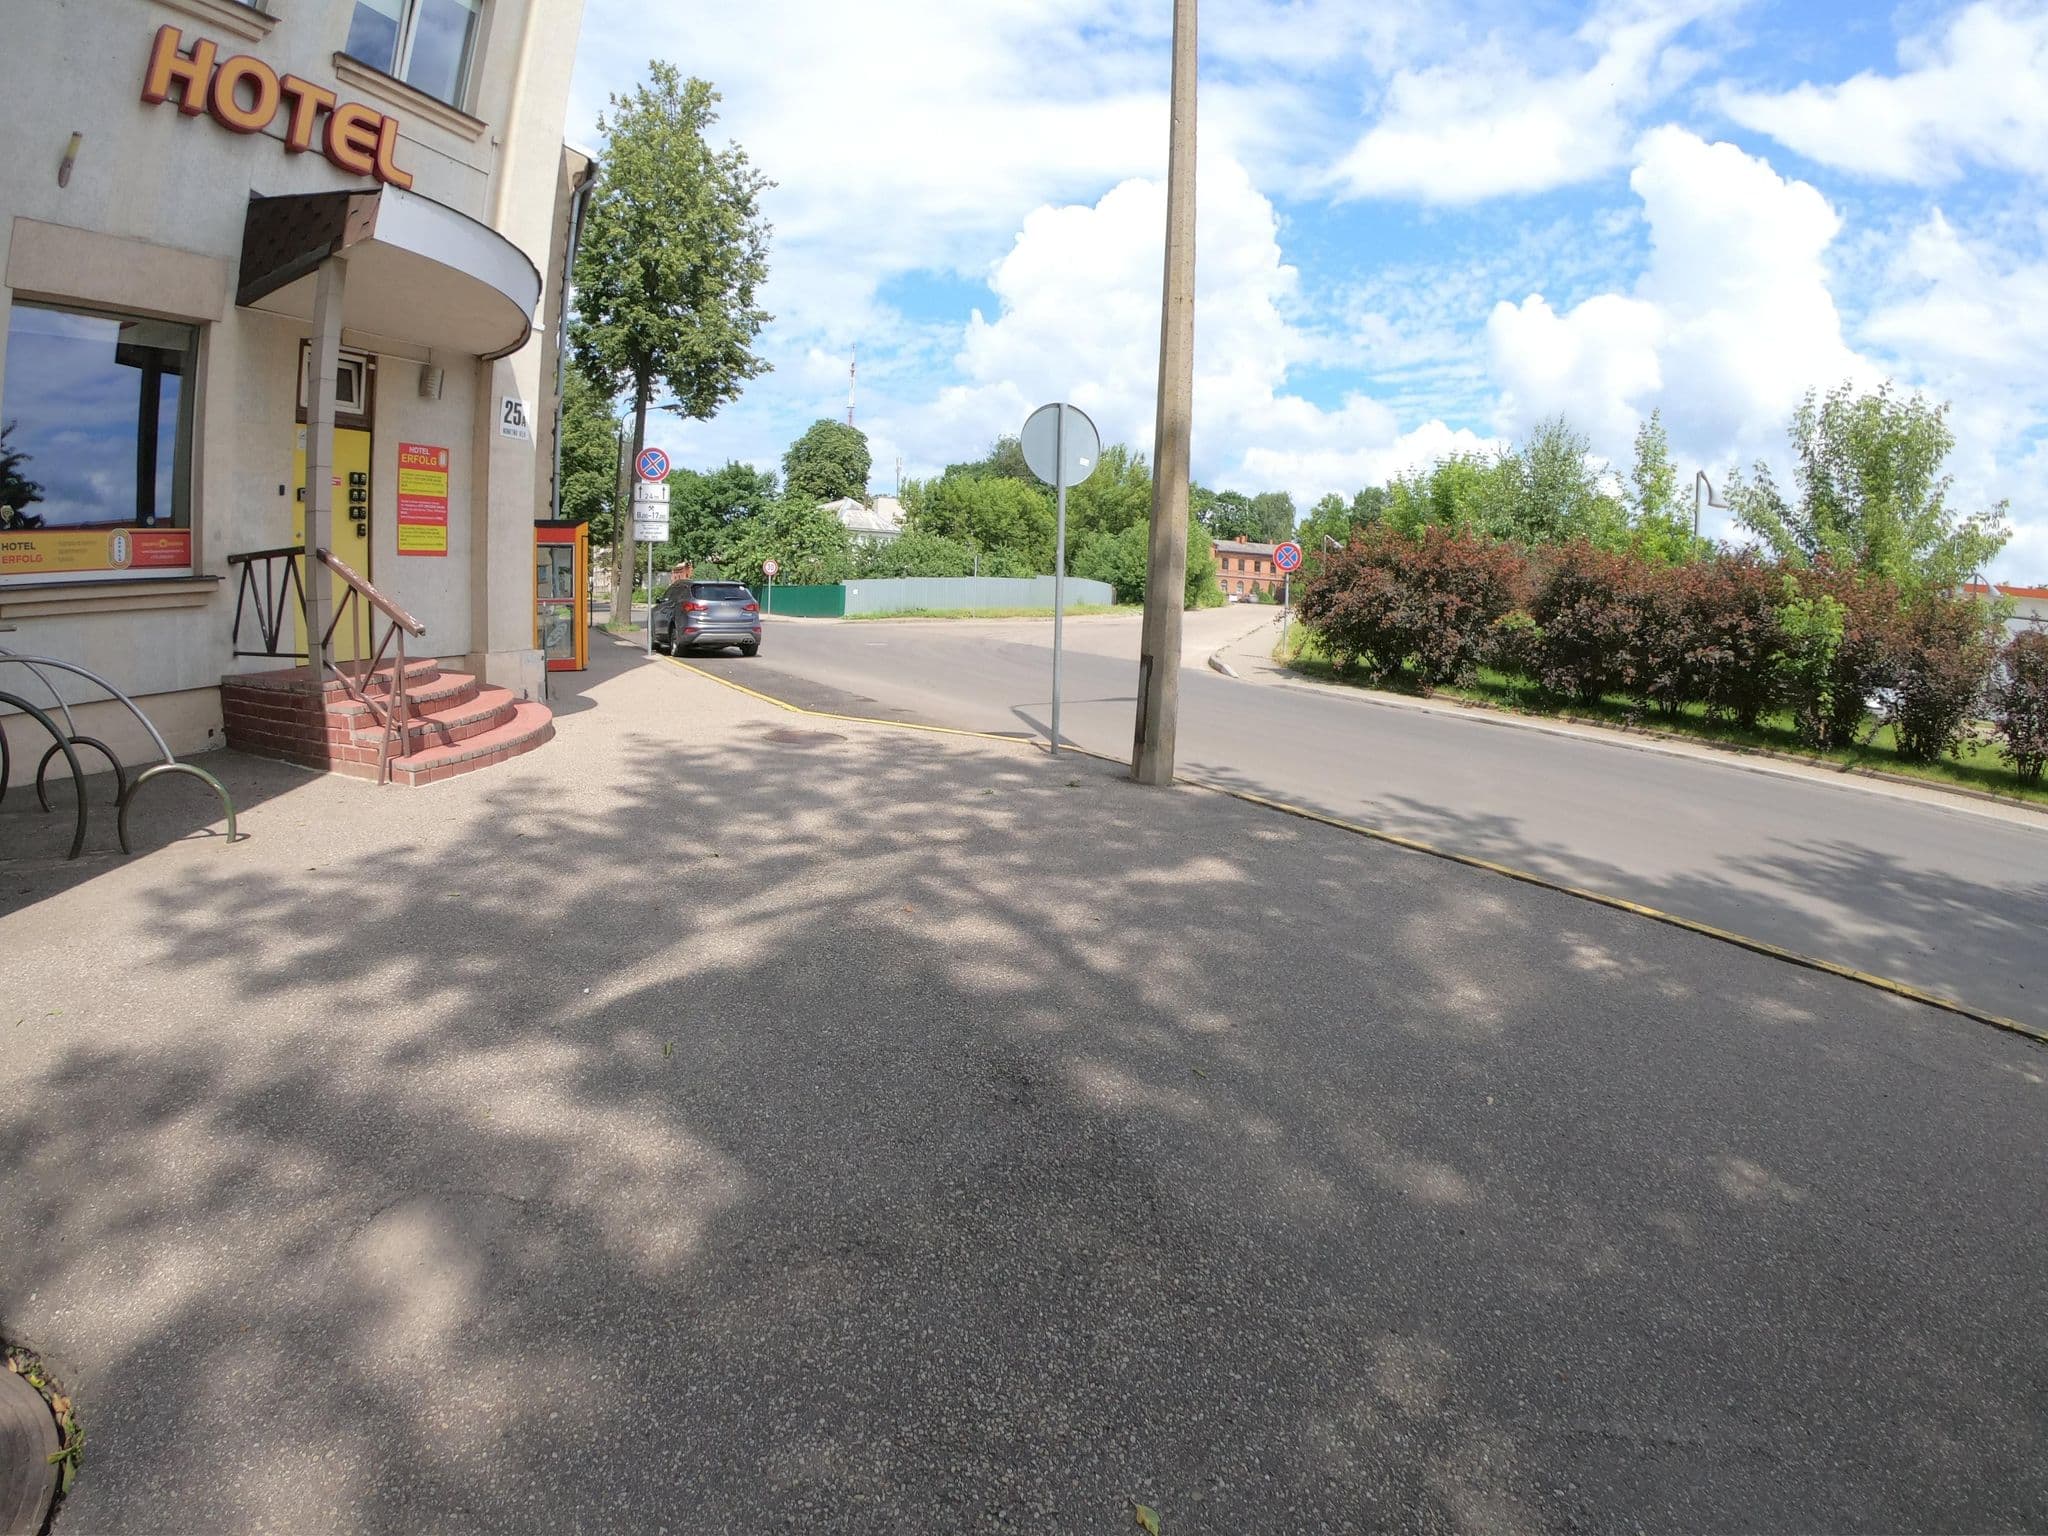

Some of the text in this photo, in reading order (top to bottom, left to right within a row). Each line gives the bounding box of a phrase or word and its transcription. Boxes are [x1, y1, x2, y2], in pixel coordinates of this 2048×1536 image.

[142, 23, 414, 190] HOTEL
[409, 446, 431, 455] HOTEL
[401, 453, 437, 466] ERFOLG
[1, 542, 36, 551] HOTEL
[1, 553, 44, 564] ERFOLG
